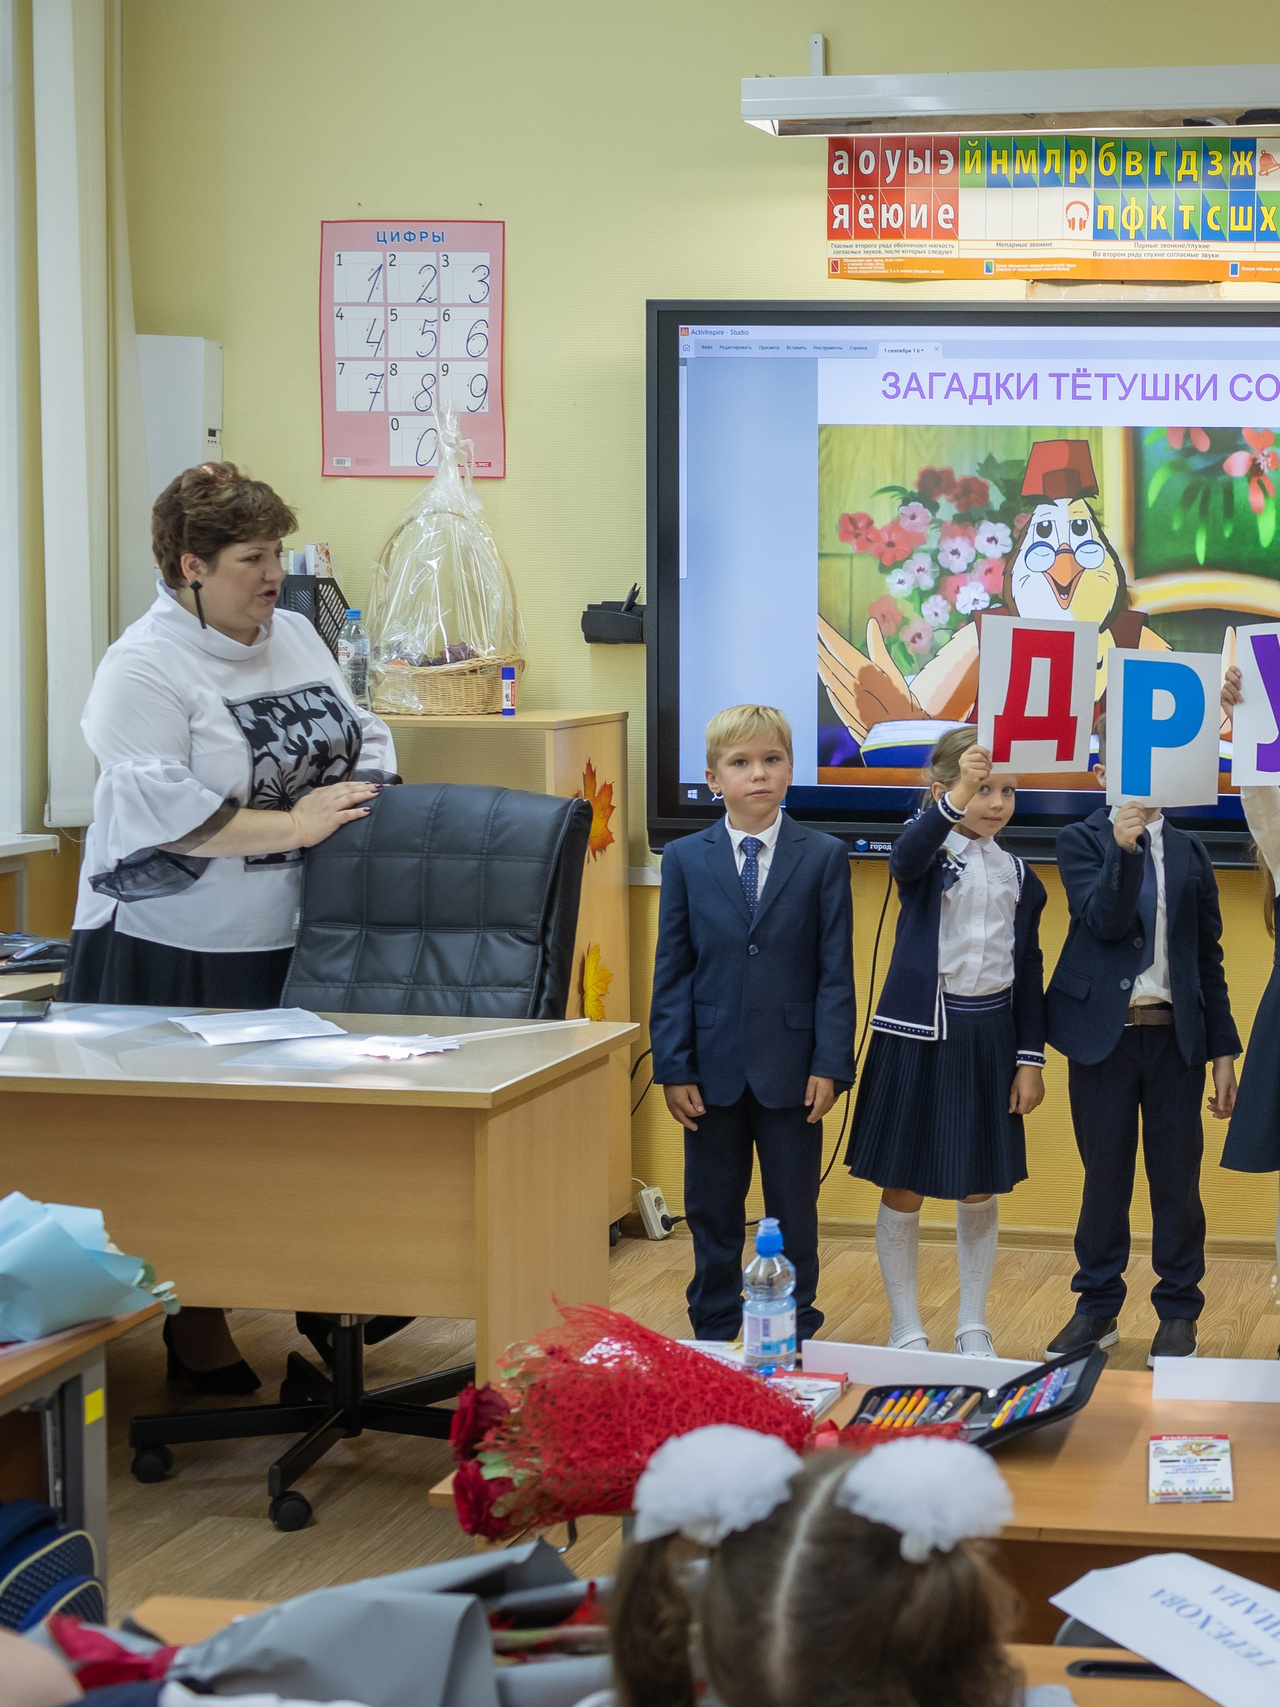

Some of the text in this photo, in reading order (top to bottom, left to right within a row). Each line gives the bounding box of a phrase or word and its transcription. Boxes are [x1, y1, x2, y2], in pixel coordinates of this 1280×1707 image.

[833, 149, 849, 175] а
[859, 149, 876, 175] о
[885, 149, 902, 184] у
[908, 149, 930, 175] ы
[938, 149, 954, 175] э
[964, 140, 982, 175] й
[991, 149, 1008, 175] н
[1015, 149, 1037, 175] м
[1044, 149, 1061, 175] л
[1069, 149, 1088, 184] р
[1098, 141, 1117, 177] б
[1125, 150, 1143, 176] в
[1154, 150, 1168, 176] г
[1177, 150, 1198, 182] д
[1207, 149, 1223, 177] з
[1231, 150, 1253, 176] ж
[375, 230, 445, 244] ЦИФРЫ
[832, 203, 849, 229] я
[858, 193, 875, 229] ё
[881, 203, 904, 229] ю
[910, 203, 928, 229] и
[937, 203, 955, 230] е
[1097, 205, 1115, 230] п
[1121, 196, 1144, 240] ф
[1151, 205, 1168, 231] к
[1178, 205, 1195, 231] т
[1206, 205, 1222, 231] с
[1230, 205, 1253, 231] ш
[1260, 205, 1277, 231] х
[1134, 242, 1210, 250] Парные звонкие/глухие
[336, 254, 490, 303] 1 1 2 2 3 3
[336, 307, 489, 357] 4 4 5 5 6 6
[730, 328, 750, 336] Studio
[337, 363, 488, 412] 7 7 8 8 9 9
[881, 371, 1038, 405] ЗАГАДКИ
[1048, 367, 1219, 402] ТЁТУШКИ
[390, 418, 438, 466] 0 0
[992, 627, 1078, 763] Д
[1121, 659, 1206, 796] Р
[1150, 1588, 1280, 1670] ТЕРЕХОВА
